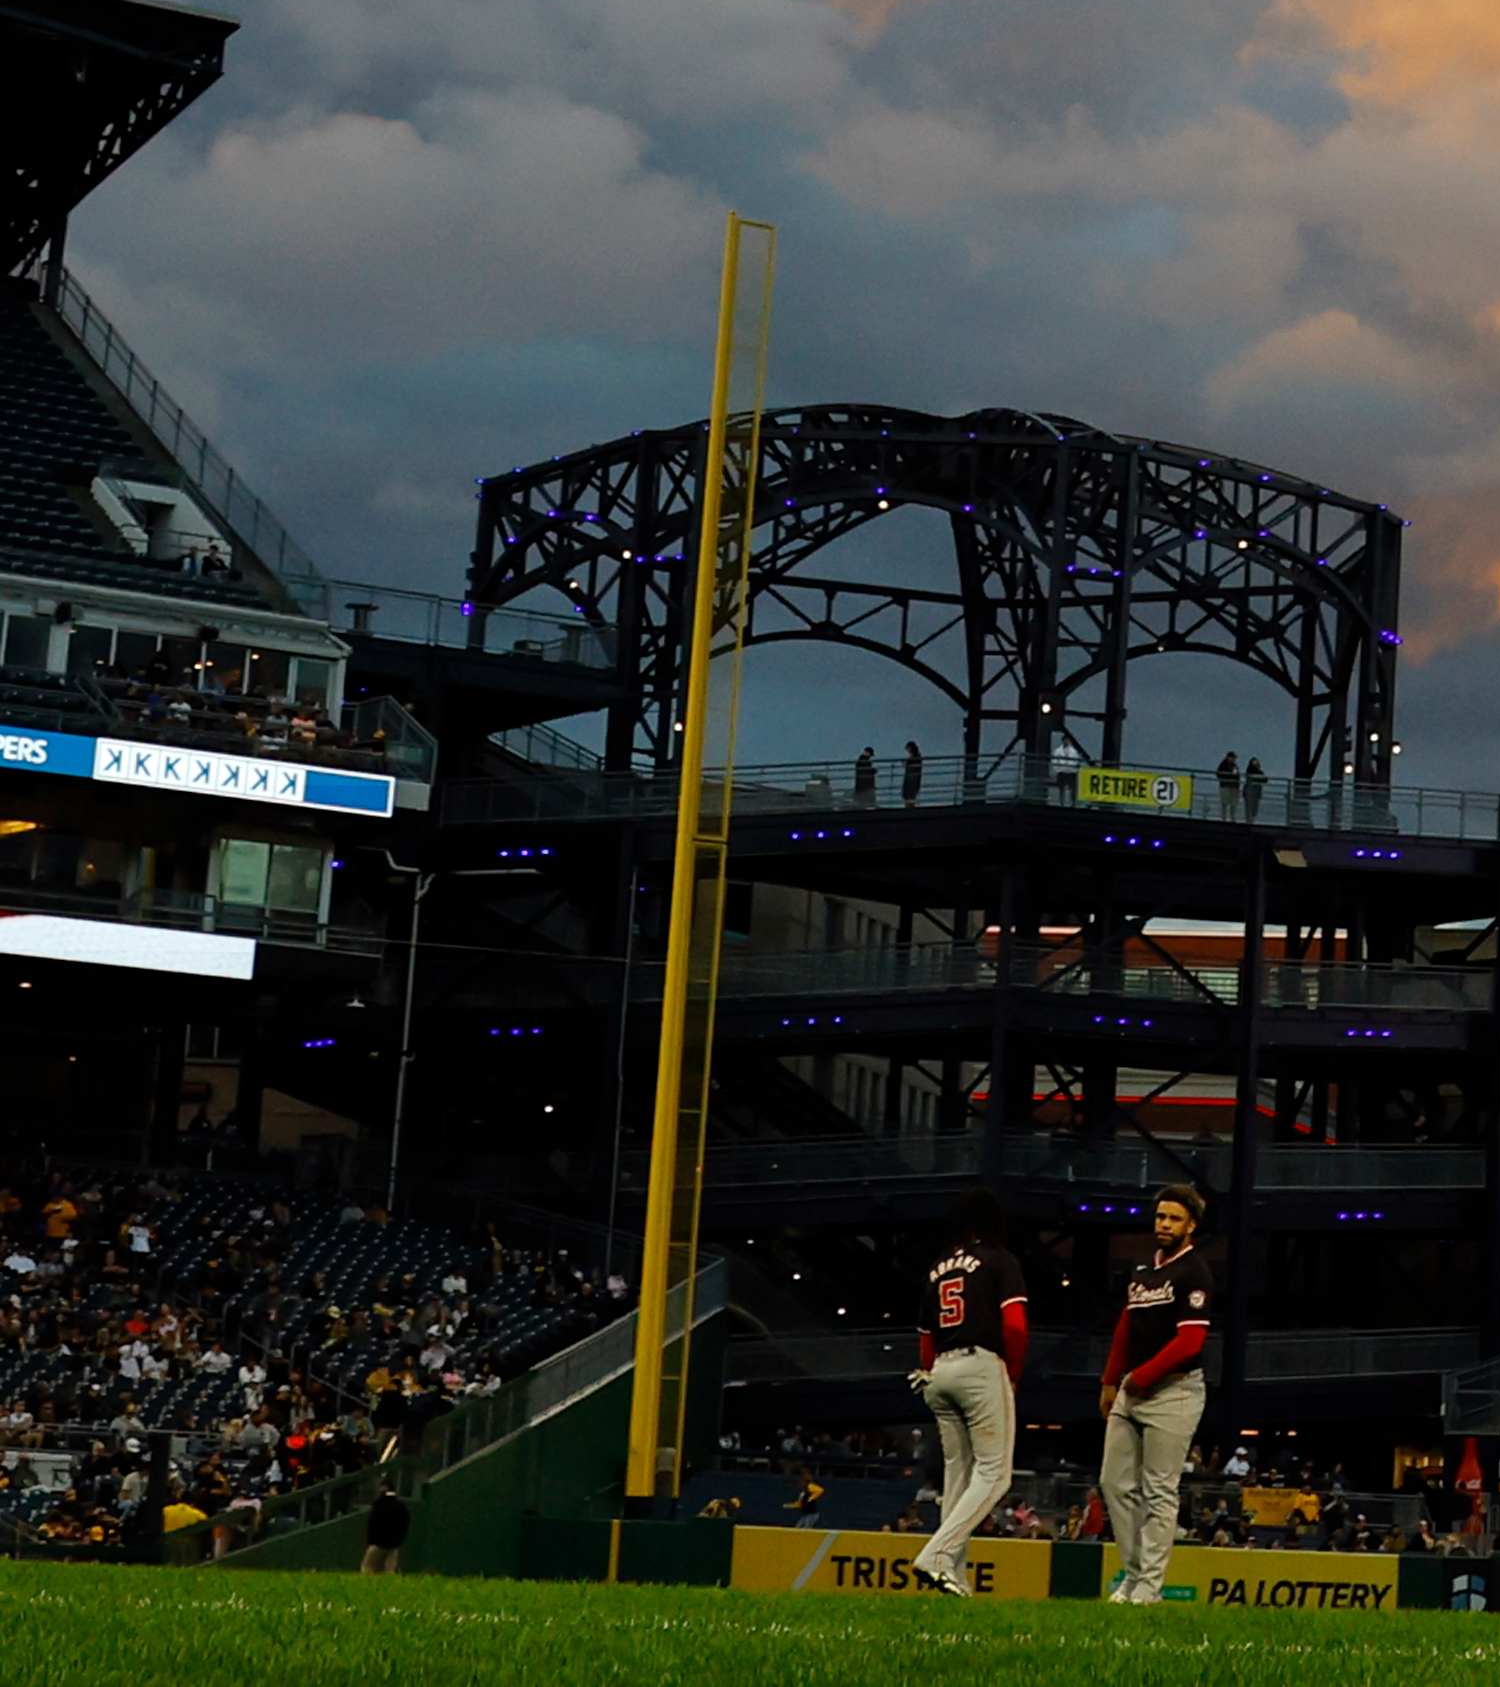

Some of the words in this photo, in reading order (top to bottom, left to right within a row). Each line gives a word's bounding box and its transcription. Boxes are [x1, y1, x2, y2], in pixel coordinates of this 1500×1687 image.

[1089, 774, 1147, 799] RETIRE
[1155, 780, 1175, 801] 21
[939, 1276, 965, 1328] 5
[831, 1555, 995, 1594] TRISE
[1208, 1578, 1247, 1606] PA
[1255, 1580, 1392, 1610] LOTTERY
